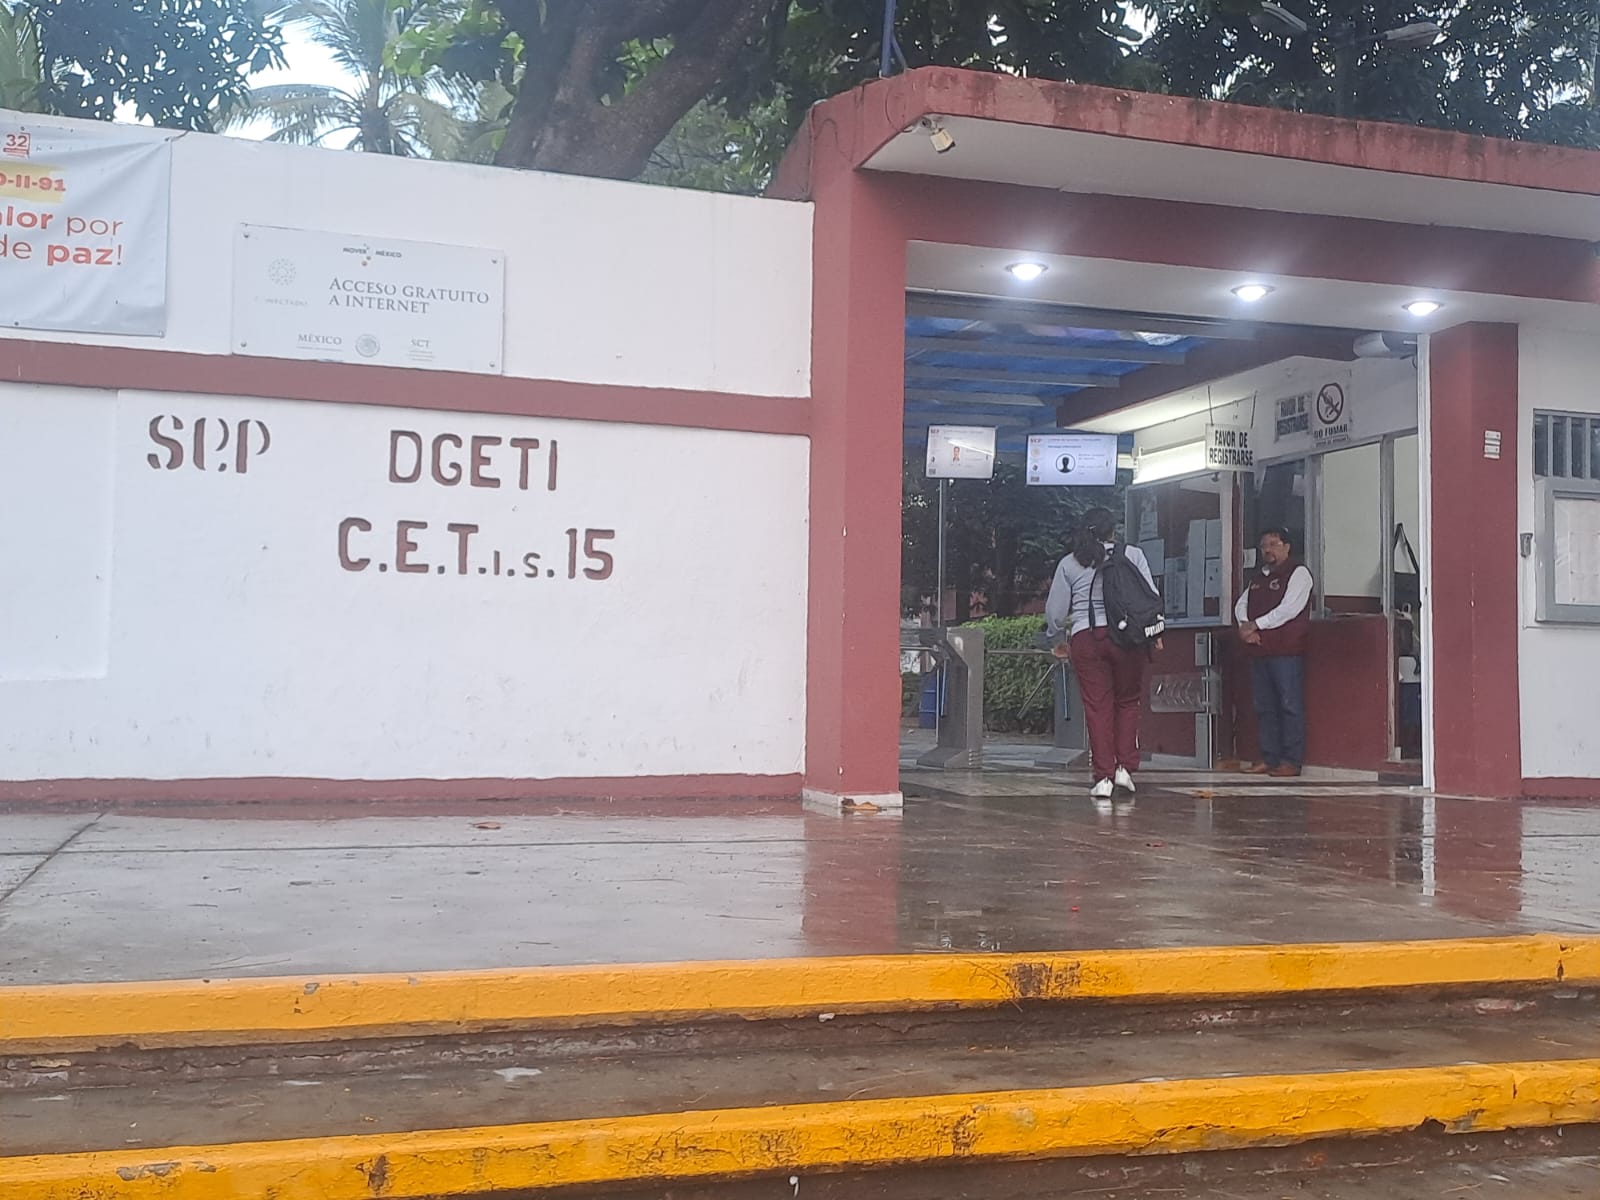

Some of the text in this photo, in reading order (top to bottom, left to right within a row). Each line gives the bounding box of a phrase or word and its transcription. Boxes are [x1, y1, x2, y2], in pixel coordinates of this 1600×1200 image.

[6, 133, 28, 148] 32
[0, 206, 124, 237] lor por
[46, 243, 122, 267] paz!
[328, 294, 340, 306] A
[346, 295, 430, 315] INTERNET
[1214, 429, 1248, 449] FAVOR DE
[388, 430, 558, 491] DGETI
[1209, 447, 1254, 467] REGISTRARSE
